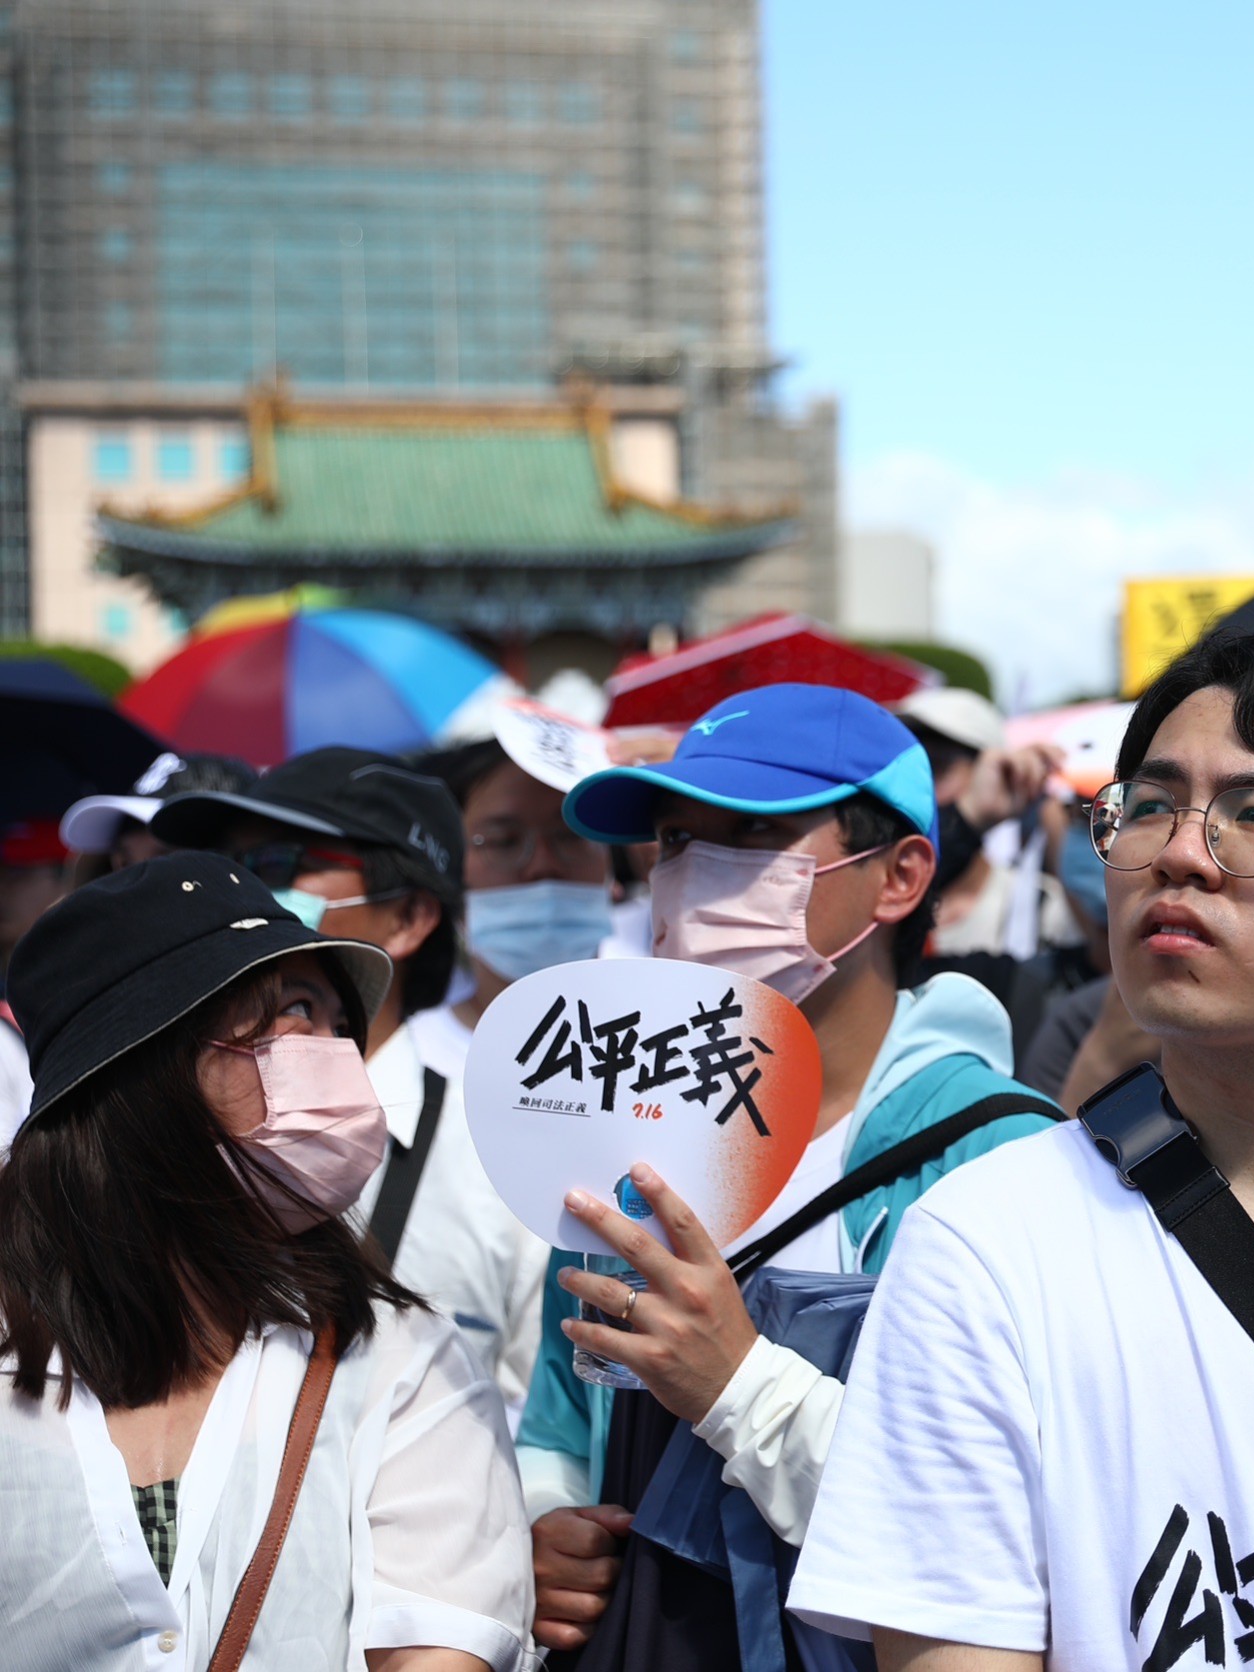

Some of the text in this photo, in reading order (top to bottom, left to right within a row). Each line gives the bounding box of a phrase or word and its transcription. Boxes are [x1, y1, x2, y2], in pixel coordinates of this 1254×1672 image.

[514, 986, 775, 1137] 公平正義
[632, 1102, 664, 1120] 7.16
